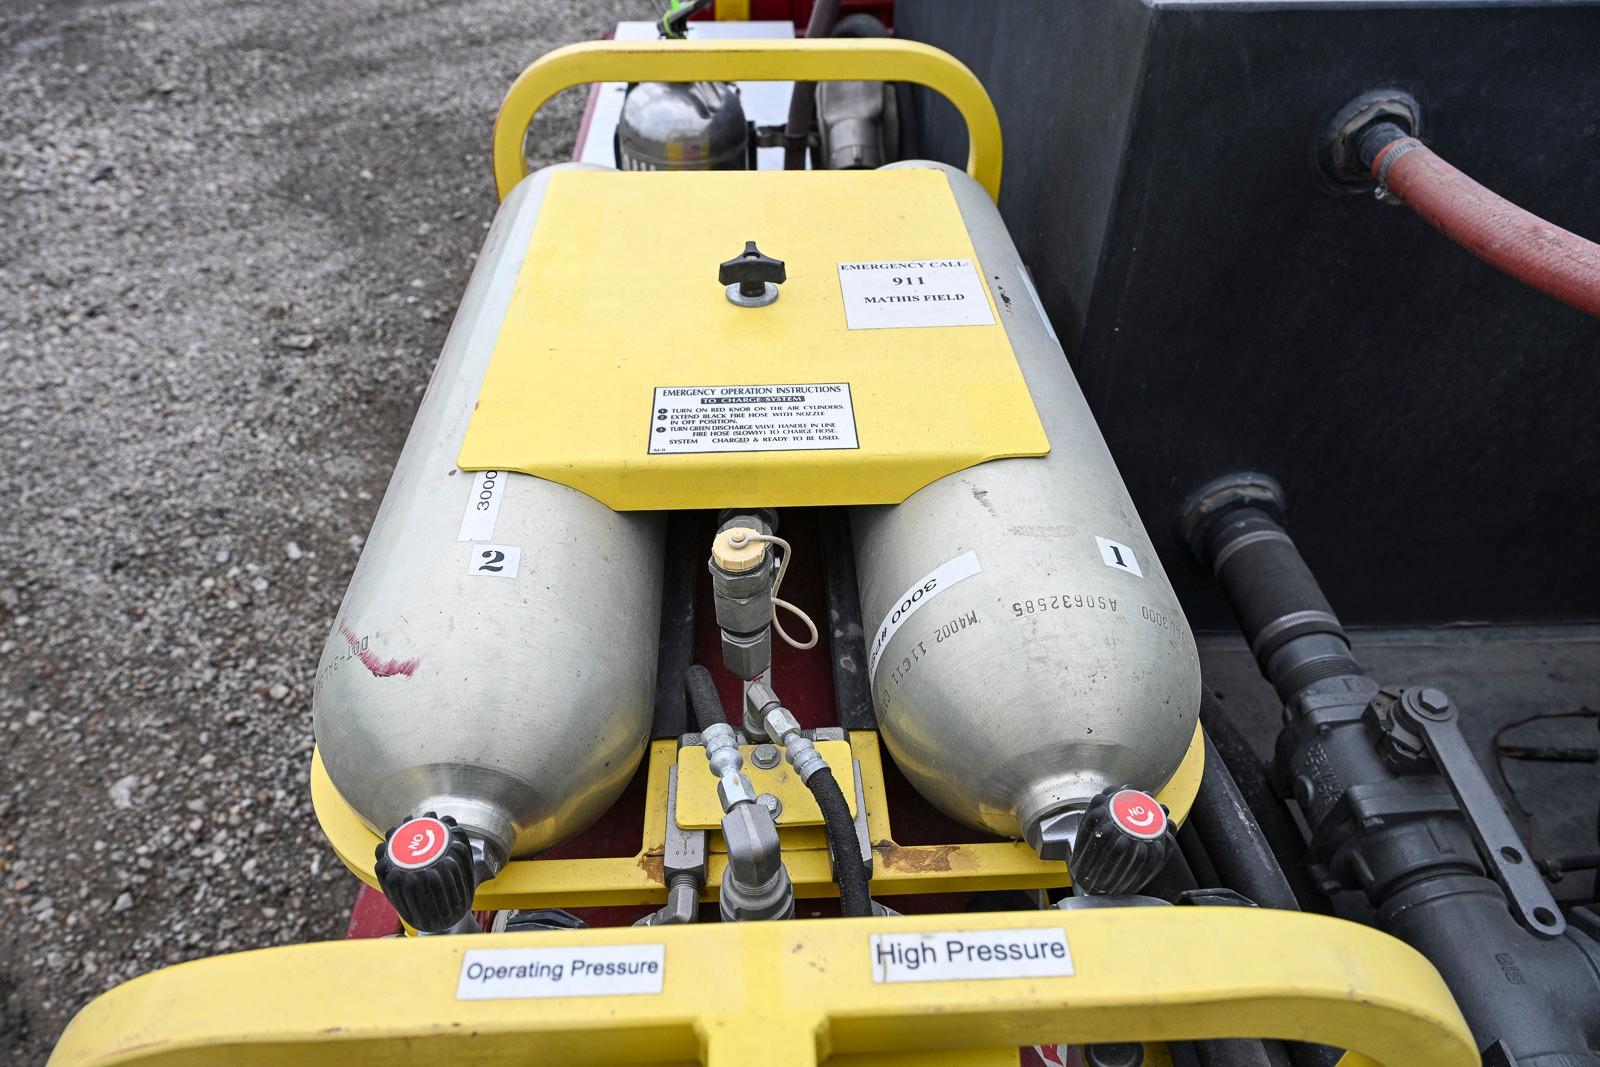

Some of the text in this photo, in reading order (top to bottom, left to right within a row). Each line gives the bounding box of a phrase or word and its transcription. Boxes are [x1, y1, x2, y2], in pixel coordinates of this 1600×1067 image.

[841, 262, 926, 271] EMERGENCY
[892, 276, 926, 286] 911
[864, 293, 965, 304] MATHIS FIELD
[662, 388, 716, 397] EMERGENCY
[776, 386, 842, 394] INSTRUCTIONS
[476, 470, 498, 510] 3000
[478, 550, 505, 572] 2
[1110, 545, 1128, 568] 1
[892, 578, 936, 624] 3000
[876, 940, 1066, 970] High Pressure
[466, 960, 658, 982] Operating Pressure
